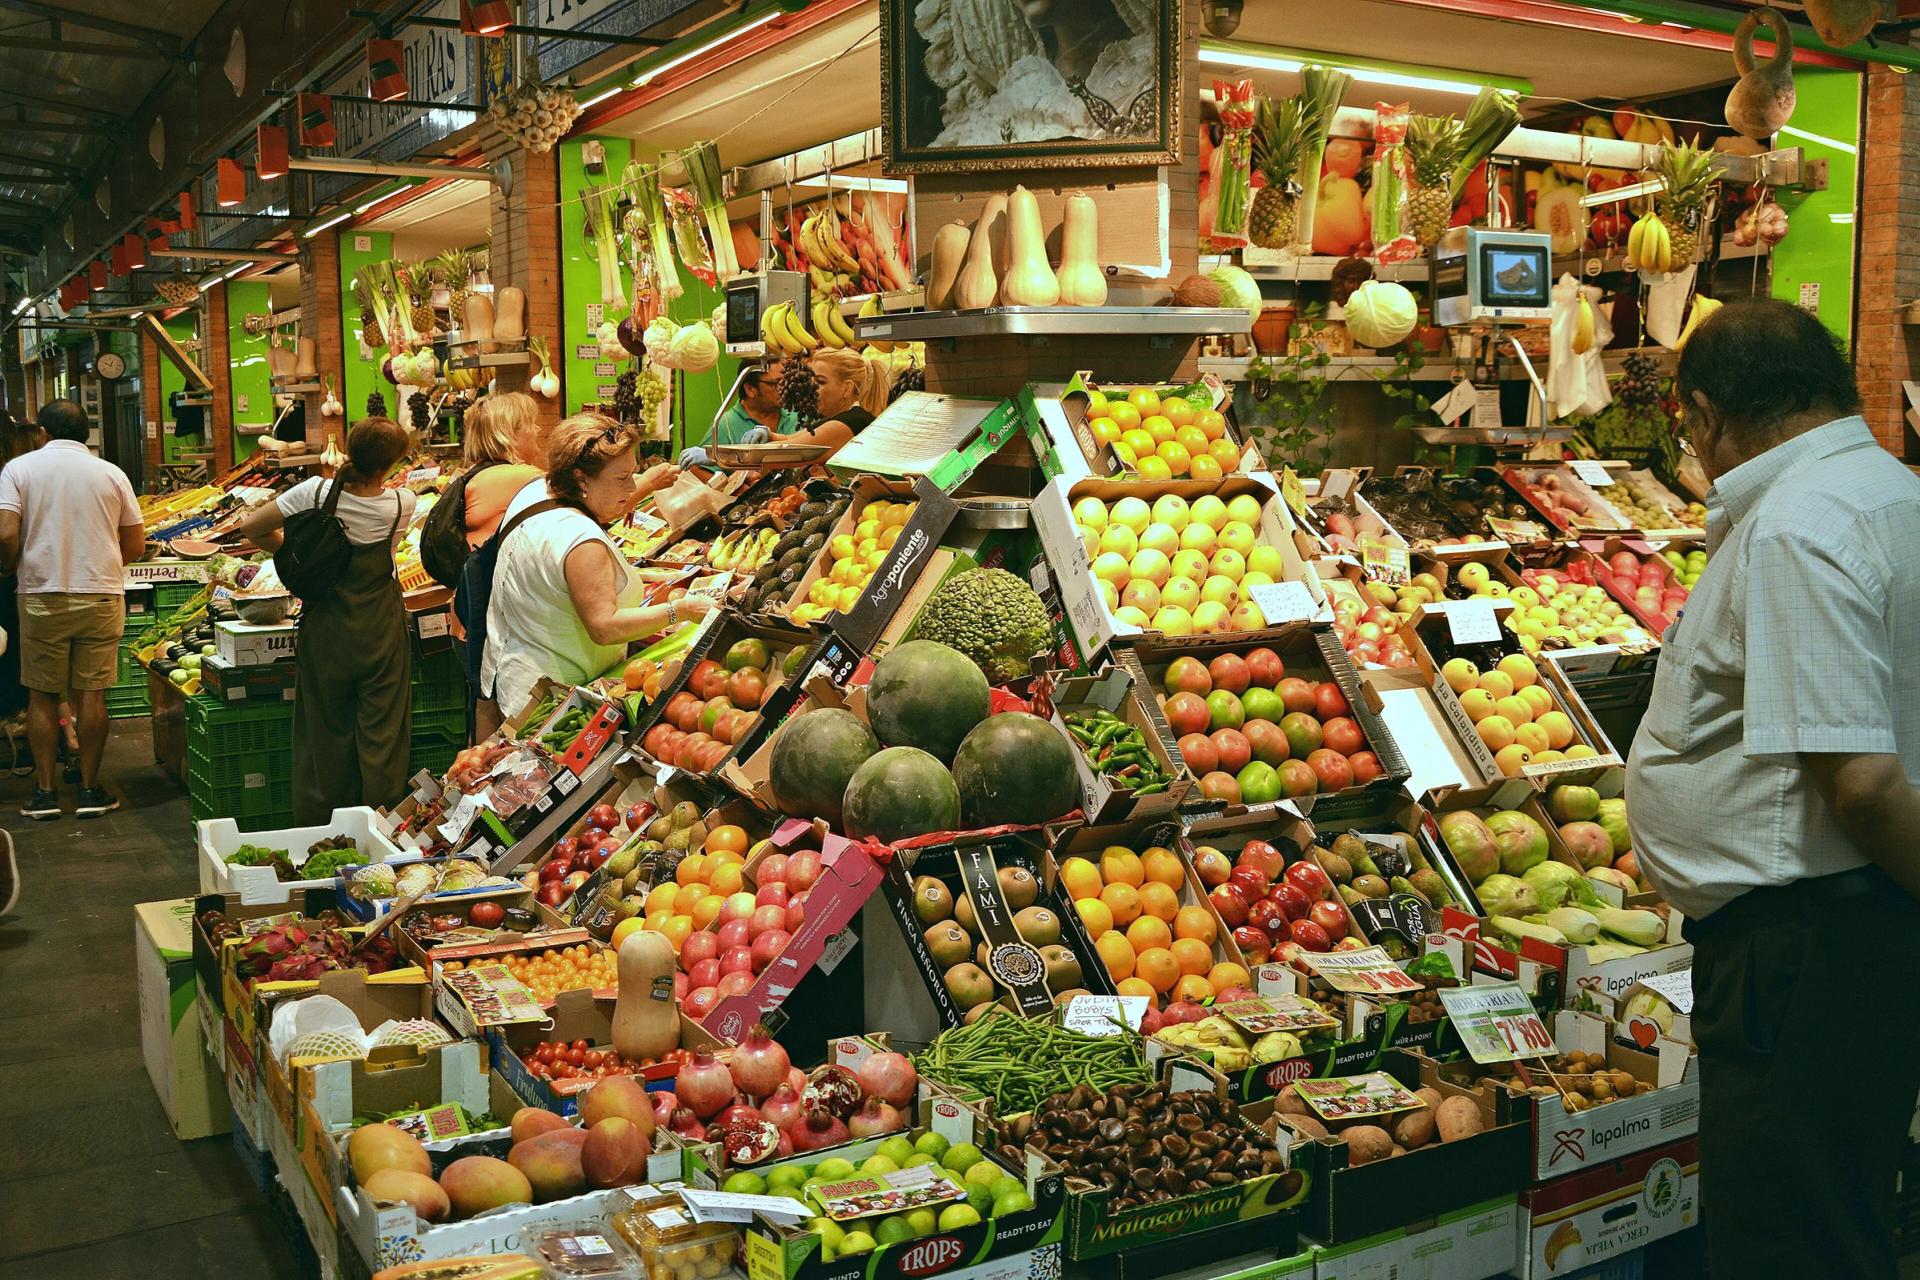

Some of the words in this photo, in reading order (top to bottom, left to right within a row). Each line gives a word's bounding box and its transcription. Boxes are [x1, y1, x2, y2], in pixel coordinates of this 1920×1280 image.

[130, 566, 179, 579] Perlim
[871, 529, 924, 607] Agroponiente
[1437, 681, 1449, 701] La
[970, 852, 1001, 926] FAMI
[1407, 918, 1420, 943] FLOR
[897, 898, 918, 945] FINCA
[916, 942, 948, 1008] SEÑORÍO
[1416, 1032, 1432, 1042] POINT
[1336, 1055, 1356, 1065] READY
[1365, 1050, 1376, 1058] EAT
[1268, 1061, 1311, 1086] TROPS
[936, 1104, 959, 1117] TROPS
[1591, 1118, 1650, 1149] lapalma
[819, 1178, 880, 1199] FRUTAS
[997, 1226, 1024, 1241] READY
[1025, 1223, 1036, 1233] TO
[1037, 1218, 1053, 1230] EAT
[1618, 1225, 1649, 1245] CERCA
[902, 1239, 961, 1272] TROPS
[1585, 1239, 1614, 1256] VIEJA
